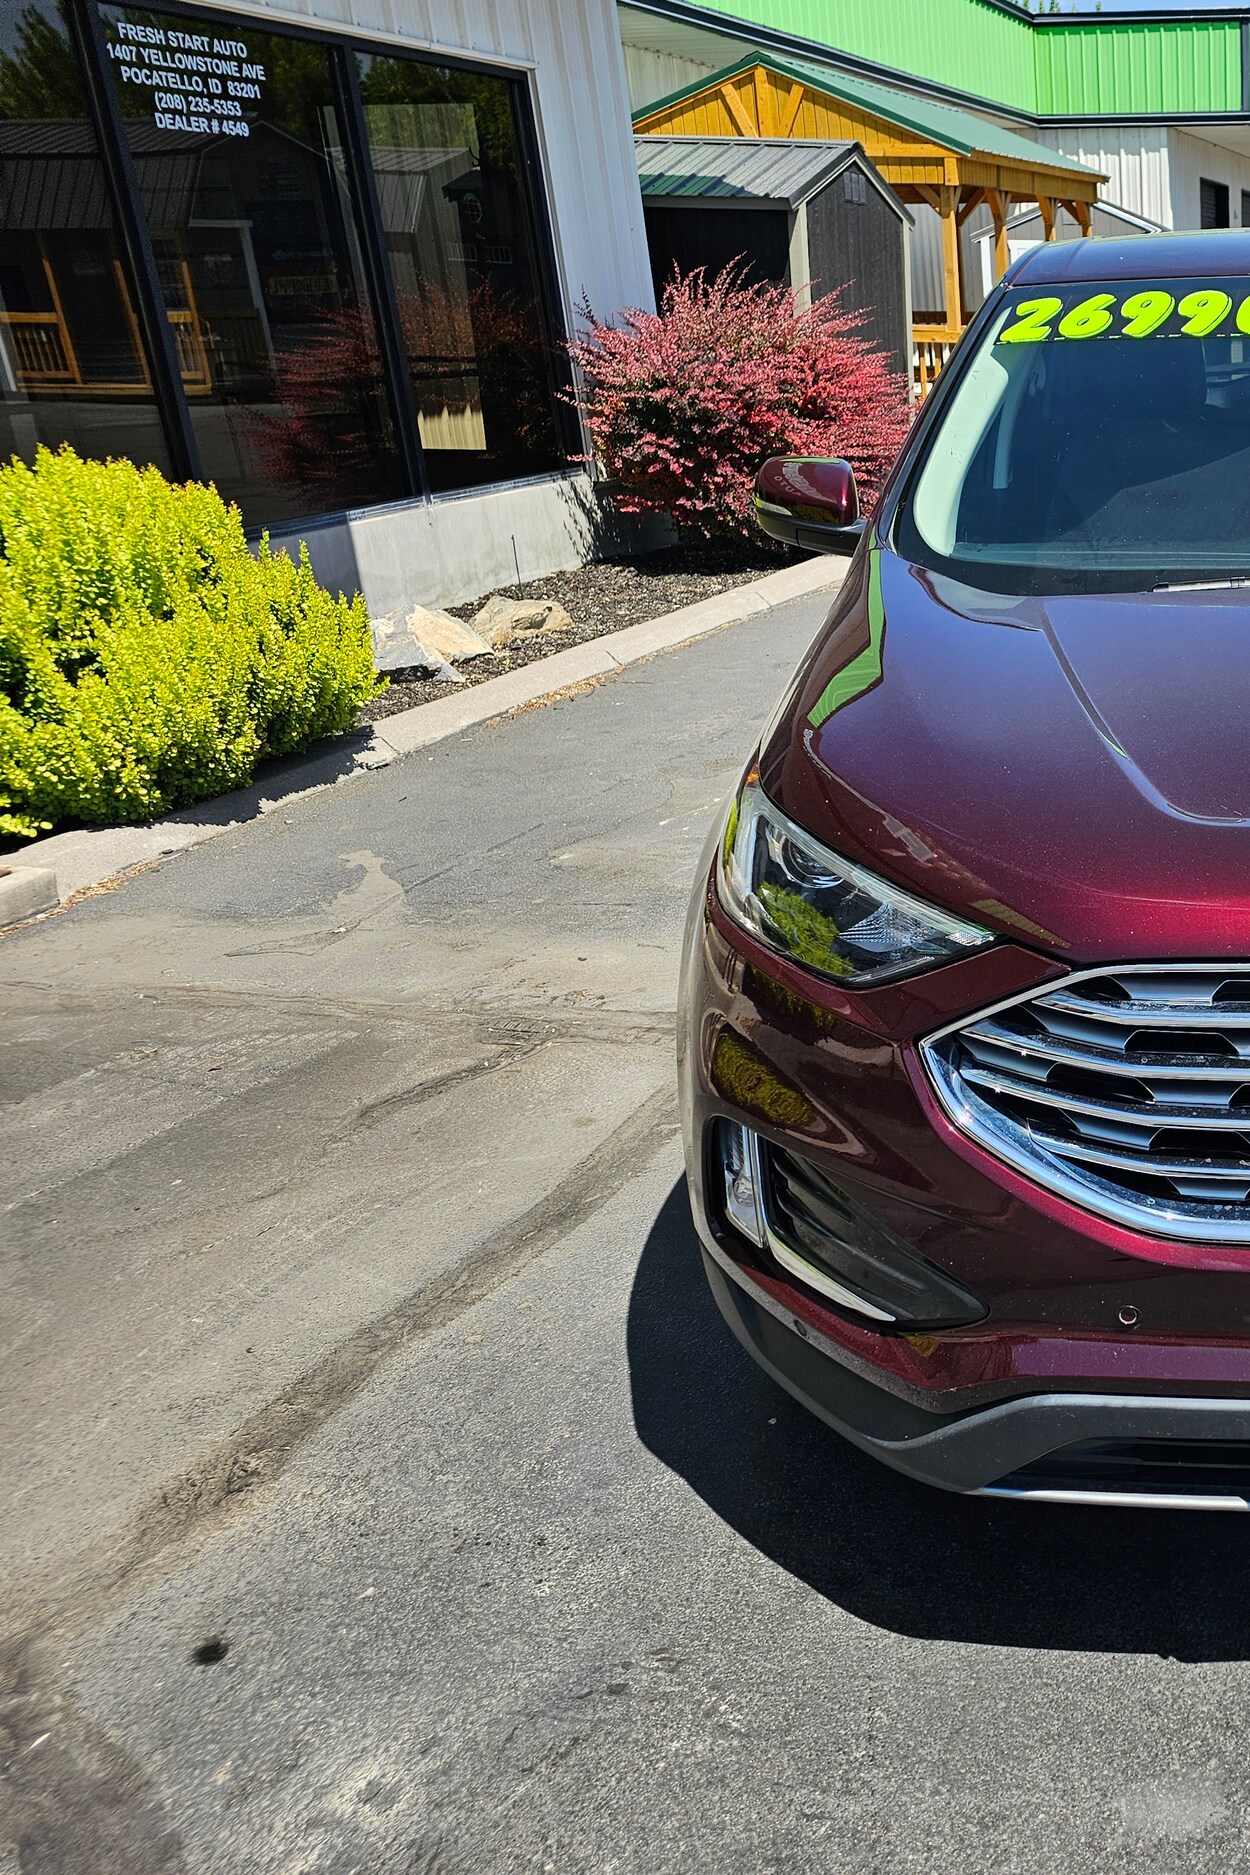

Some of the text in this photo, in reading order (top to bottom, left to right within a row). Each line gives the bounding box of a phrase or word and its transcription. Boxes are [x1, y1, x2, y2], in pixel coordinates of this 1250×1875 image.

[116, 22, 248, 58] FRESH START AUTO
[106, 42, 267, 81] 1407 YELLOWSTONE AVE
[120, 65, 261, 99] POCATELLO, ID 83201
[154, 91, 243, 117] (208) 235-5353
[154, 112, 250, 138] DEALER # 4549
